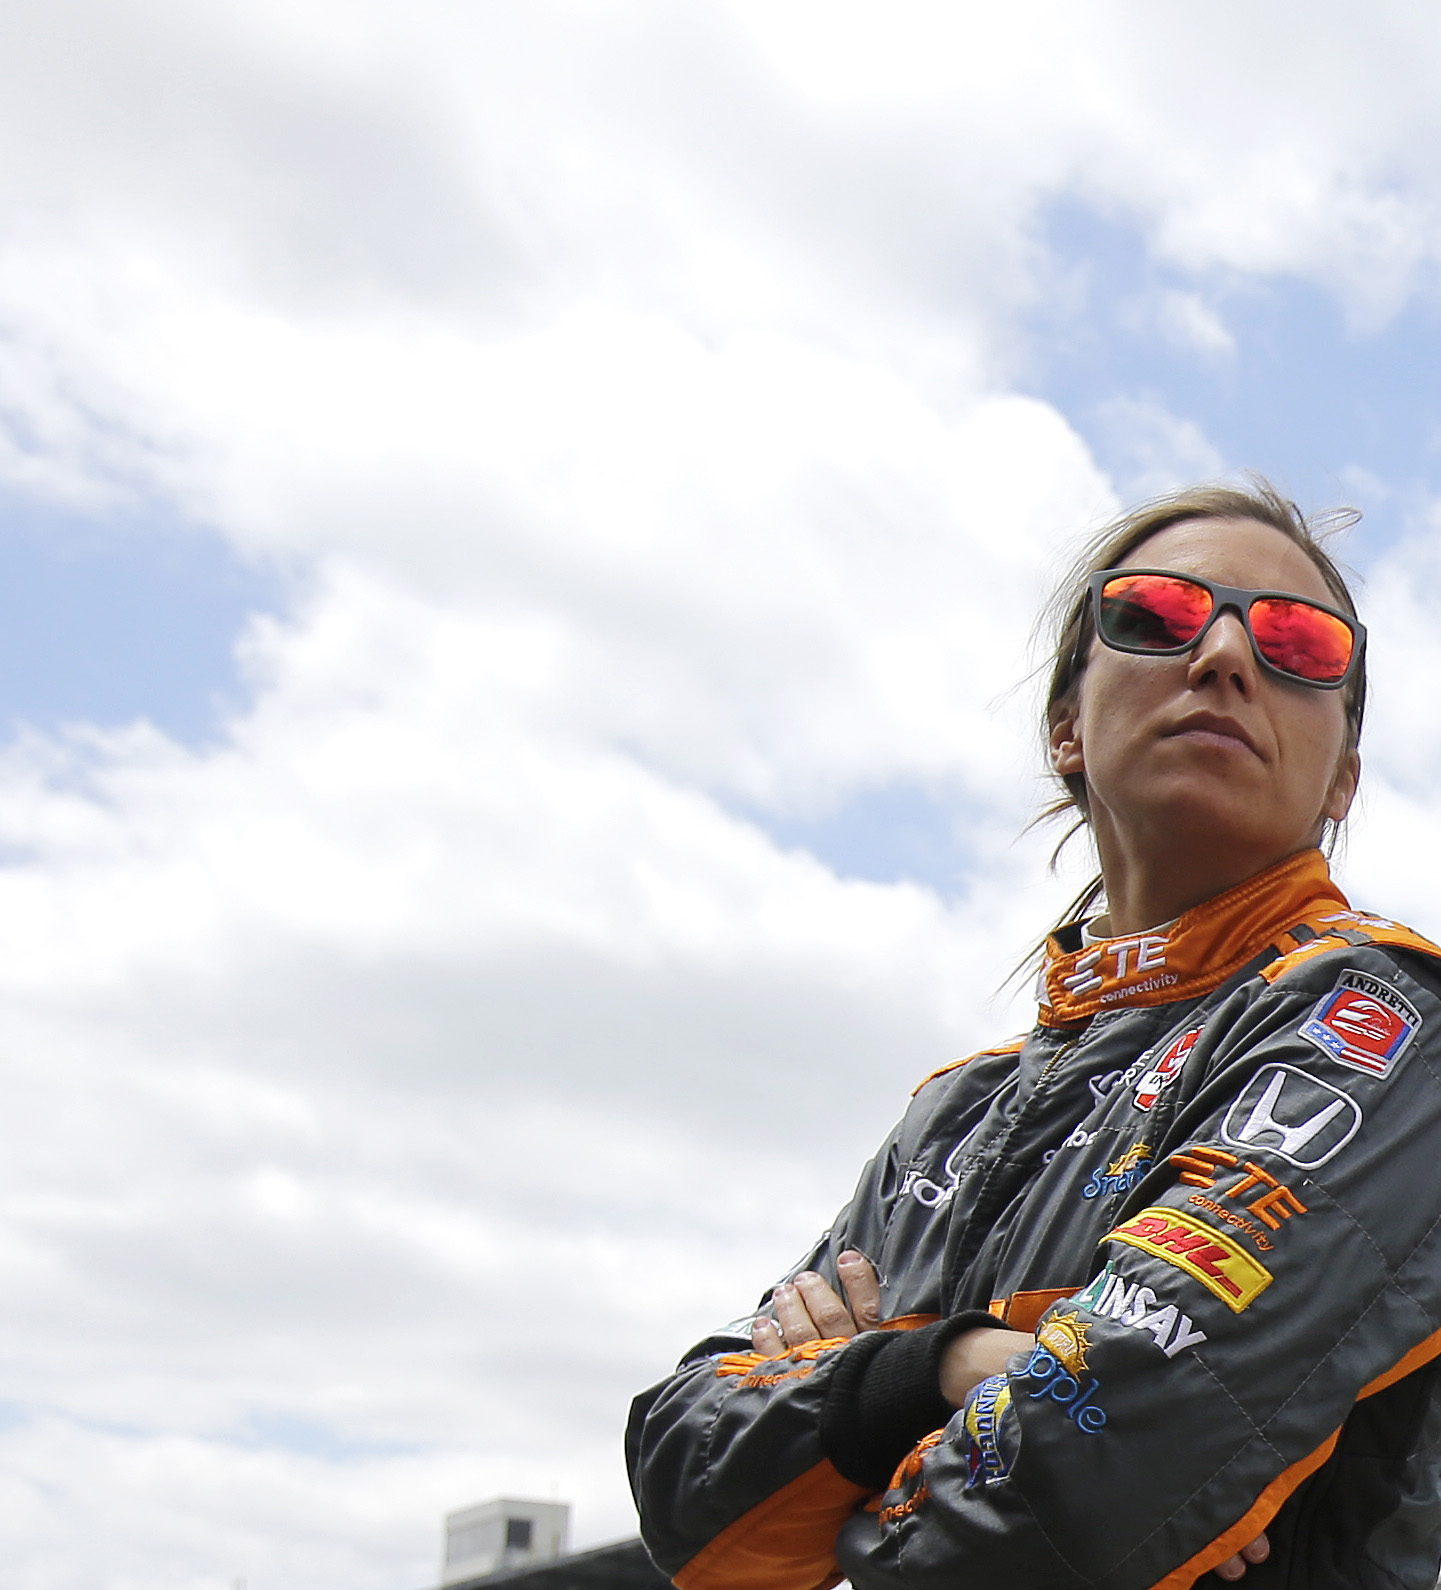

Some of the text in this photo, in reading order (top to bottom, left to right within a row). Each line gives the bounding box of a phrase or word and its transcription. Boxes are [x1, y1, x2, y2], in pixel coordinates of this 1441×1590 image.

[1107, 936, 1170, 979] TE
[1101, 973, 1178, 1003] connectivity
[1342, 974, 1418, 1027] ANDRETTI
[1188, 1193, 1275, 1252] connectivity
[1225, 1161, 1309, 1231] TE
[1113, 1217, 1232, 1278] DHL
[1011, 1342, 1107, 1434] pple
[975, 1373, 1010, 1471] SUNOCO
